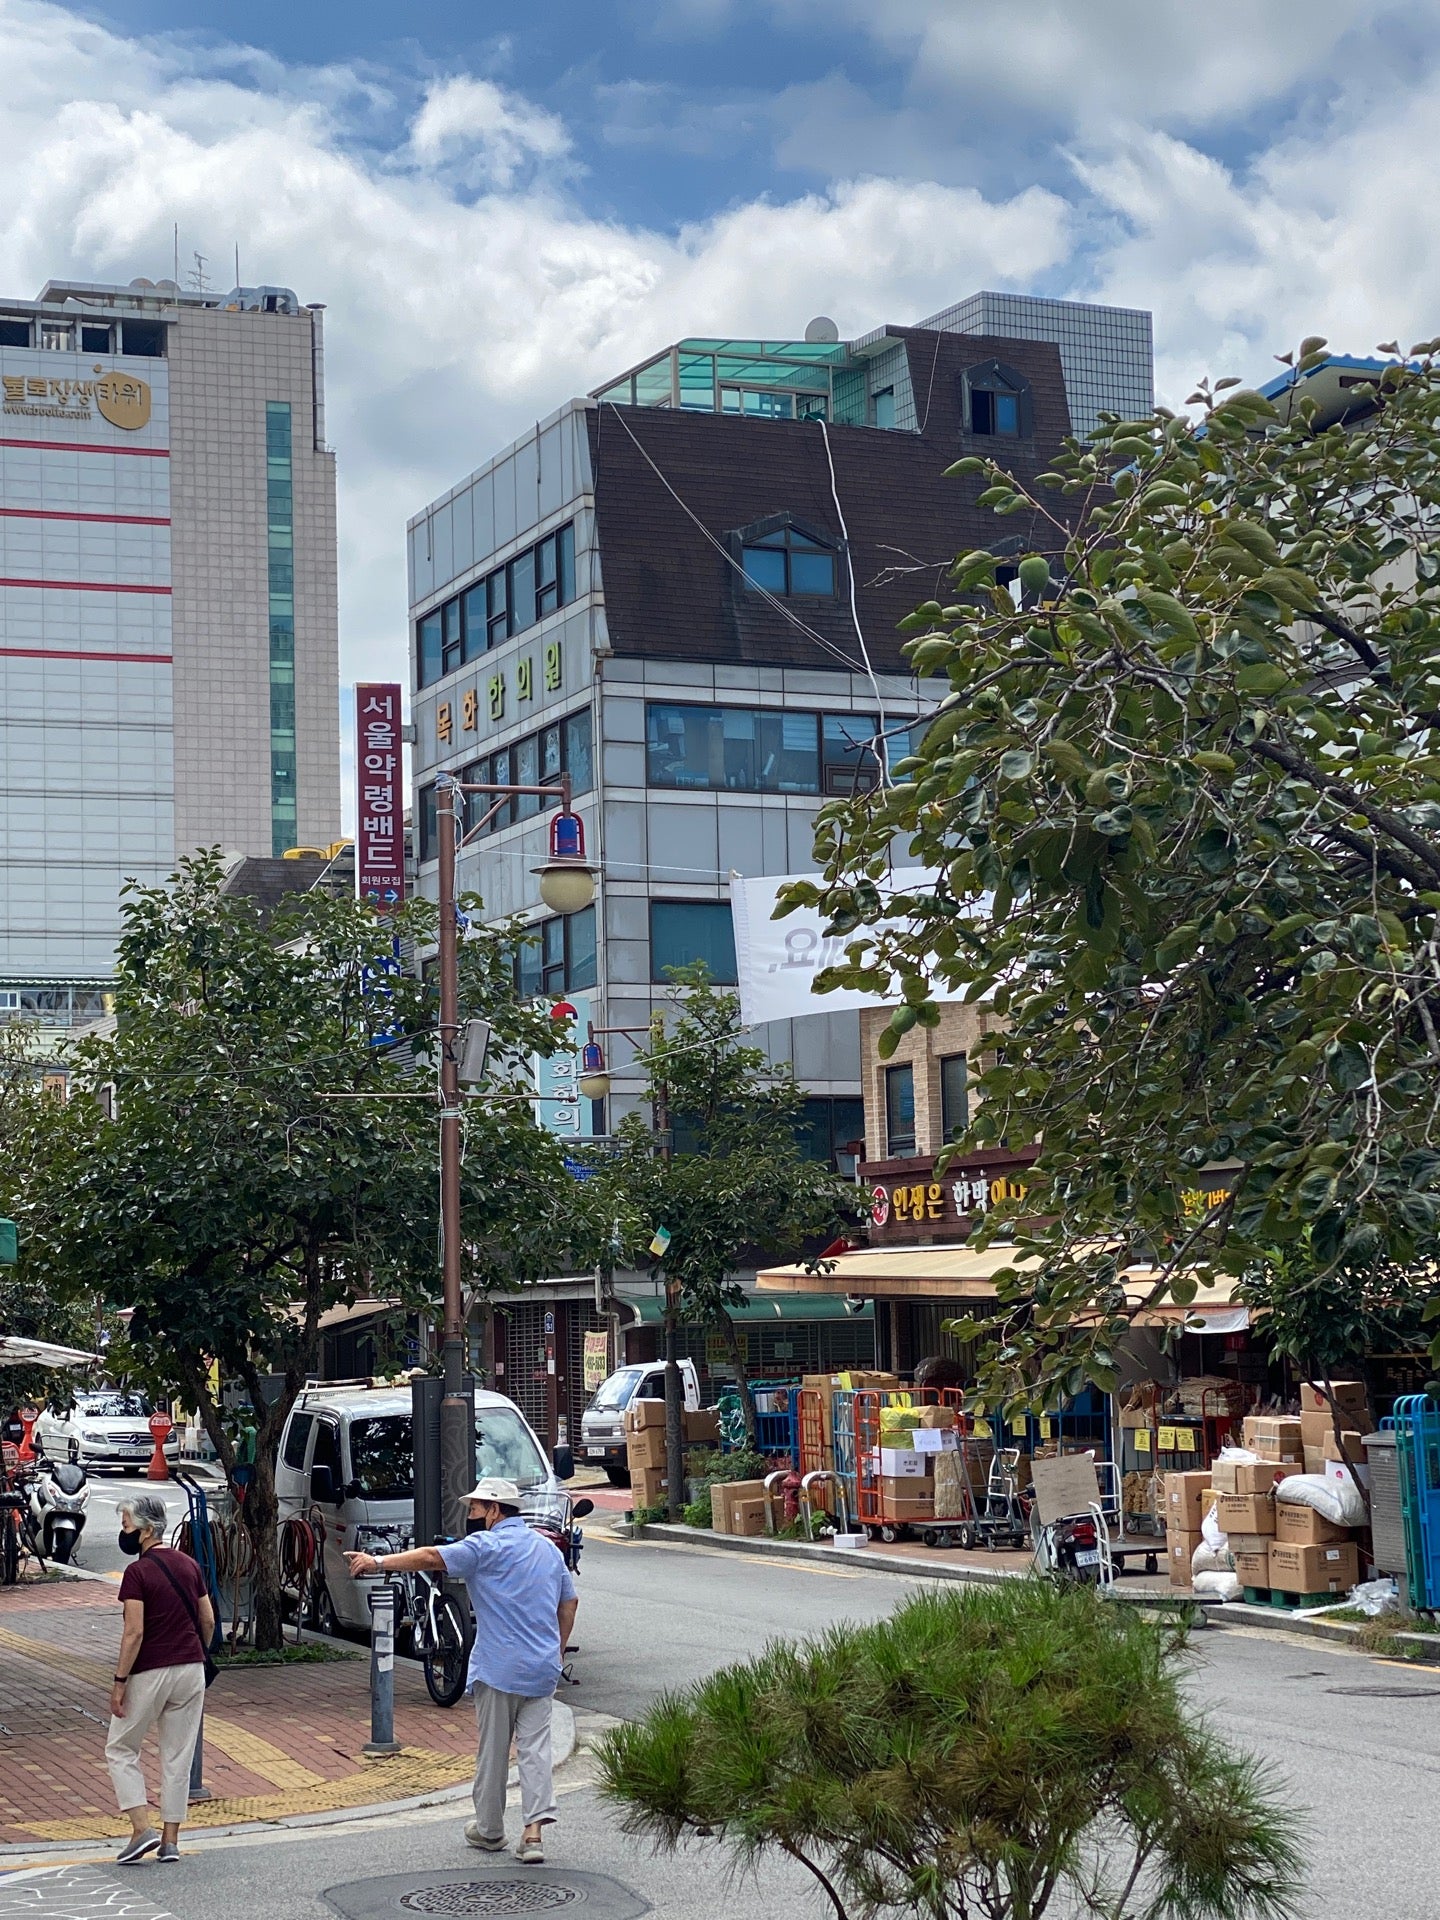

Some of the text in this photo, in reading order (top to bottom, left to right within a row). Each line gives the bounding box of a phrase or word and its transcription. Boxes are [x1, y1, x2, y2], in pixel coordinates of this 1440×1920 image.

[437, 641, 562, 745] 목화한의원
[363, 696, 397, 869] 서울약령밴드
[361, 876, 401, 886] 회원모집
[893, 1184, 943, 1221] 인생은
